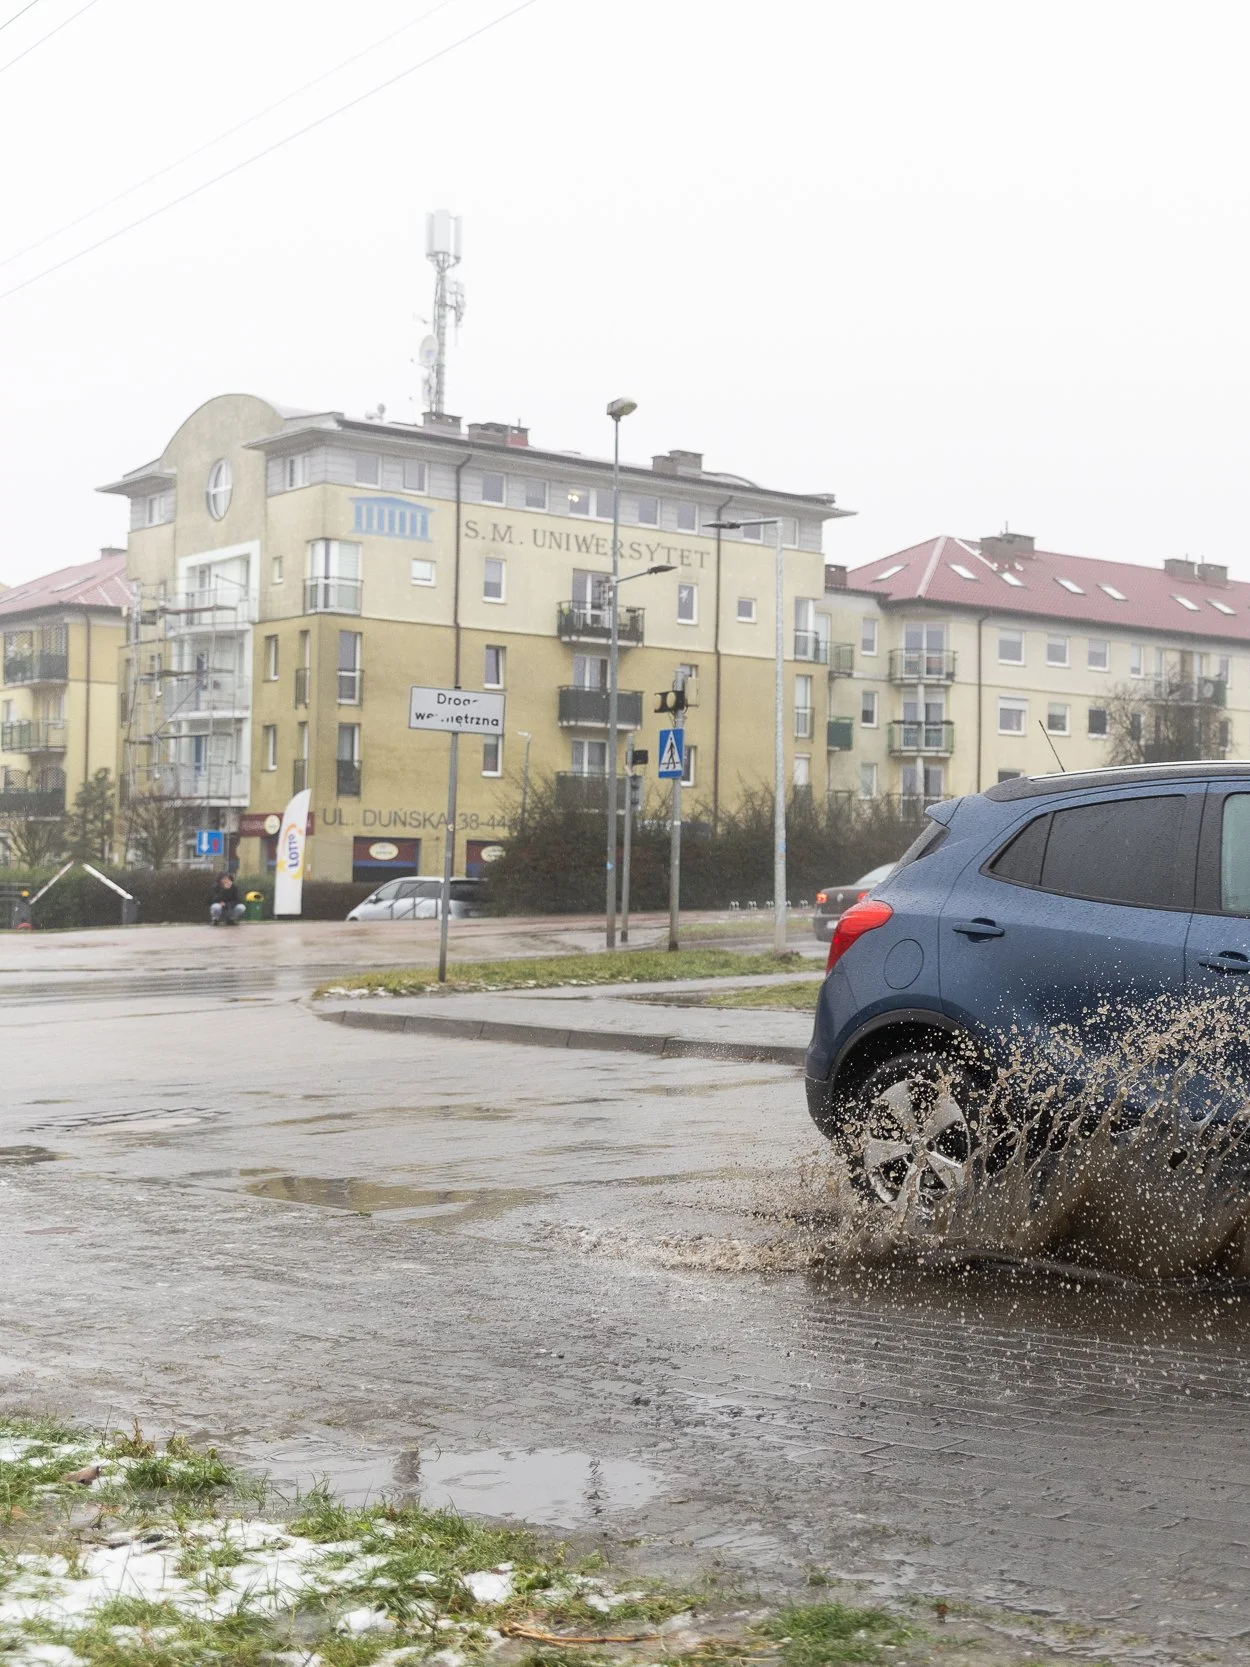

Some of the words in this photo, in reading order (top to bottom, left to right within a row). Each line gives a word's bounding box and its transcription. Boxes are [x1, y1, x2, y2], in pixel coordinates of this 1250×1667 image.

[532, 527, 711, 569] UNIWERSYTET
[322, 808, 354, 827] UL.
[363, 808, 448, 830] DUŃSKA
